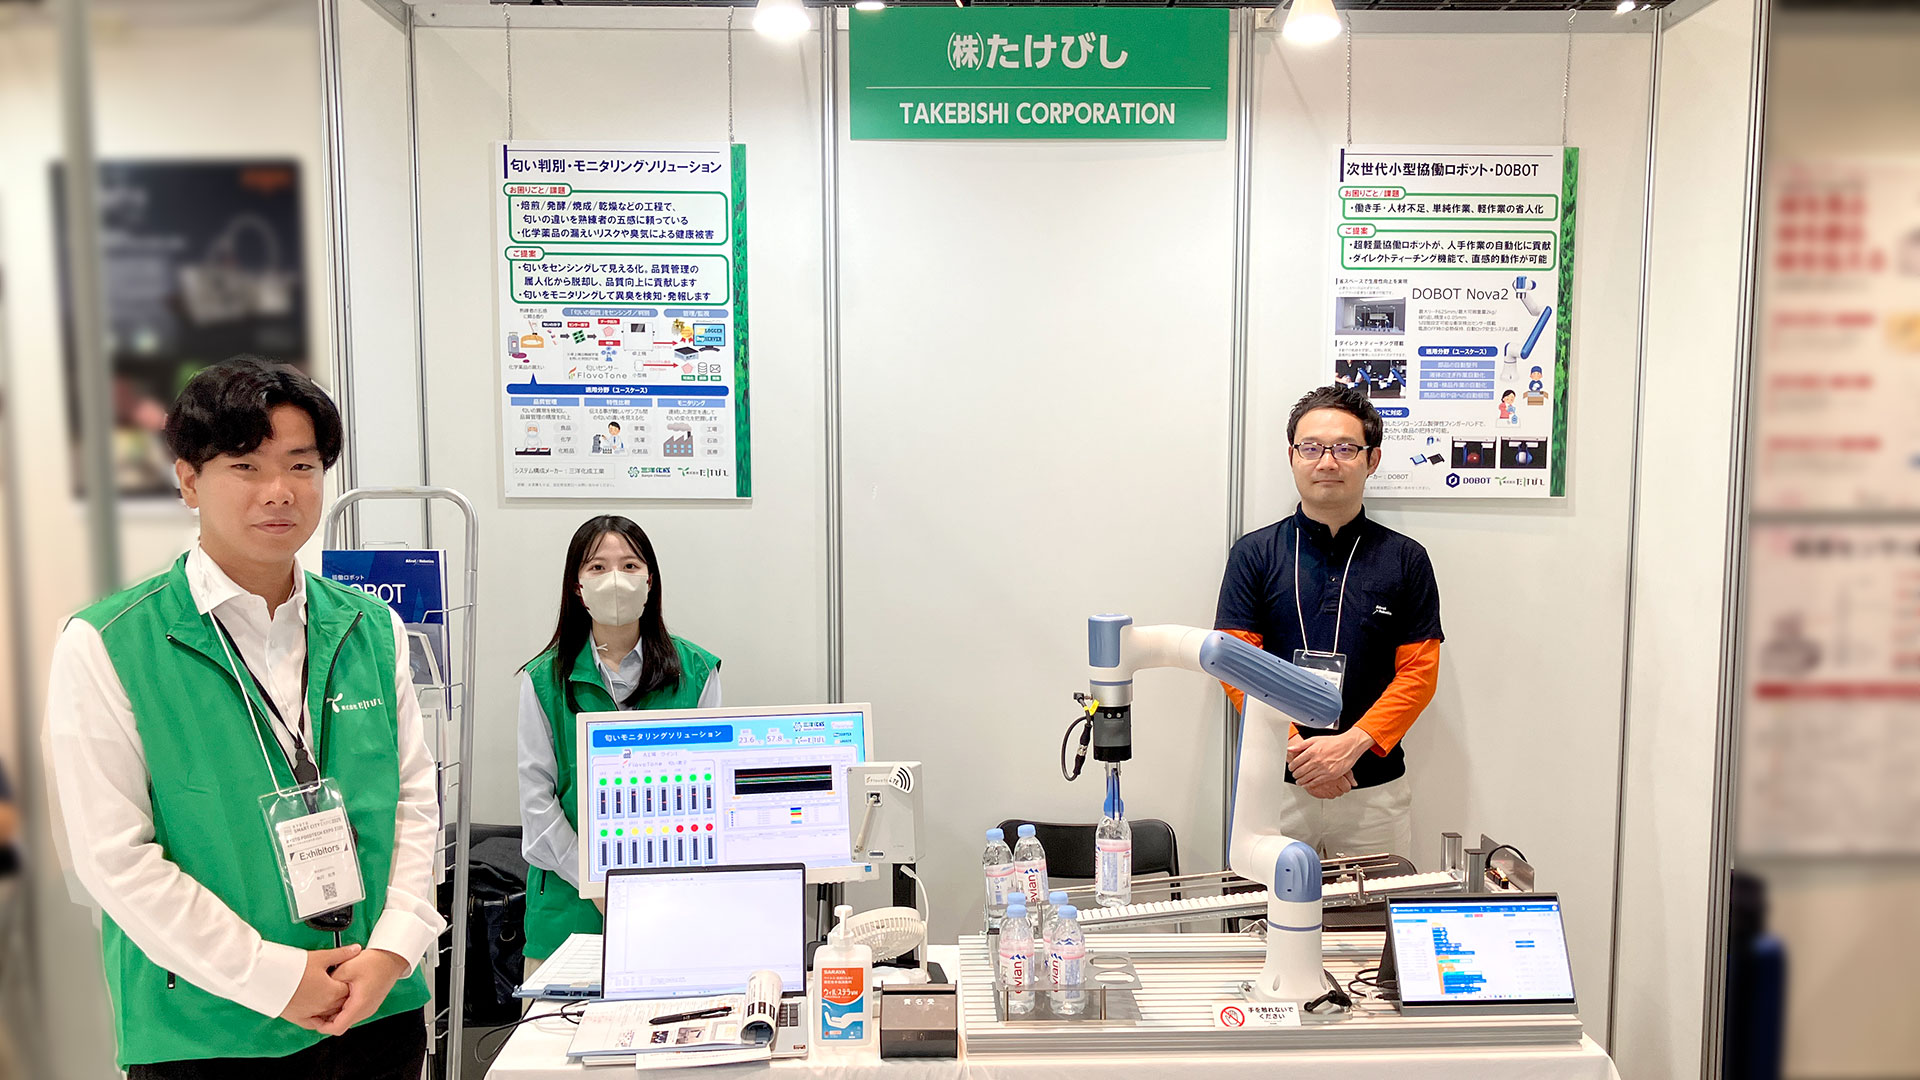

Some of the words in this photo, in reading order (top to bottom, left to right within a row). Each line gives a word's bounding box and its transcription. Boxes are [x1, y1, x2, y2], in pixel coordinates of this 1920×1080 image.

[899, 102, 1009, 124] TAKEBISHI
[1016, 102, 1175, 124] CORPORATION
[510, 159, 722, 173] 匂い判別・モニタリングソリューション
[1346, 162, 1539, 177] 次世代小型協働ロボット・DOBOT
[509, 186, 566, 195] お困りごと/課題
[1344, 189, 1400, 198] お困りごと/課題
[523, 215, 689, 225] 匂いの違いを熟練者の五感に頼っている
[517, 229, 714, 240] ・化学薬品の漏えいリスクや臭気による健康被害
[1345, 227, 1369, 235] ご提案
[512, 250, 537, 258] ご提案
[524, 277, 697, 288] 属人化から脱却し、品質向上に貢献します
[518, 290, 711, 301] ・匂いをモニタリングして異臭を検知・発報します
[1412, 288, 1462, 300] DOBOT
[1466, 288, 1509, 300] Nova2
[604, 730, 722, 742] 匂いモニタリングソリューション
[299, 844, 340, 861] Exhibitors
